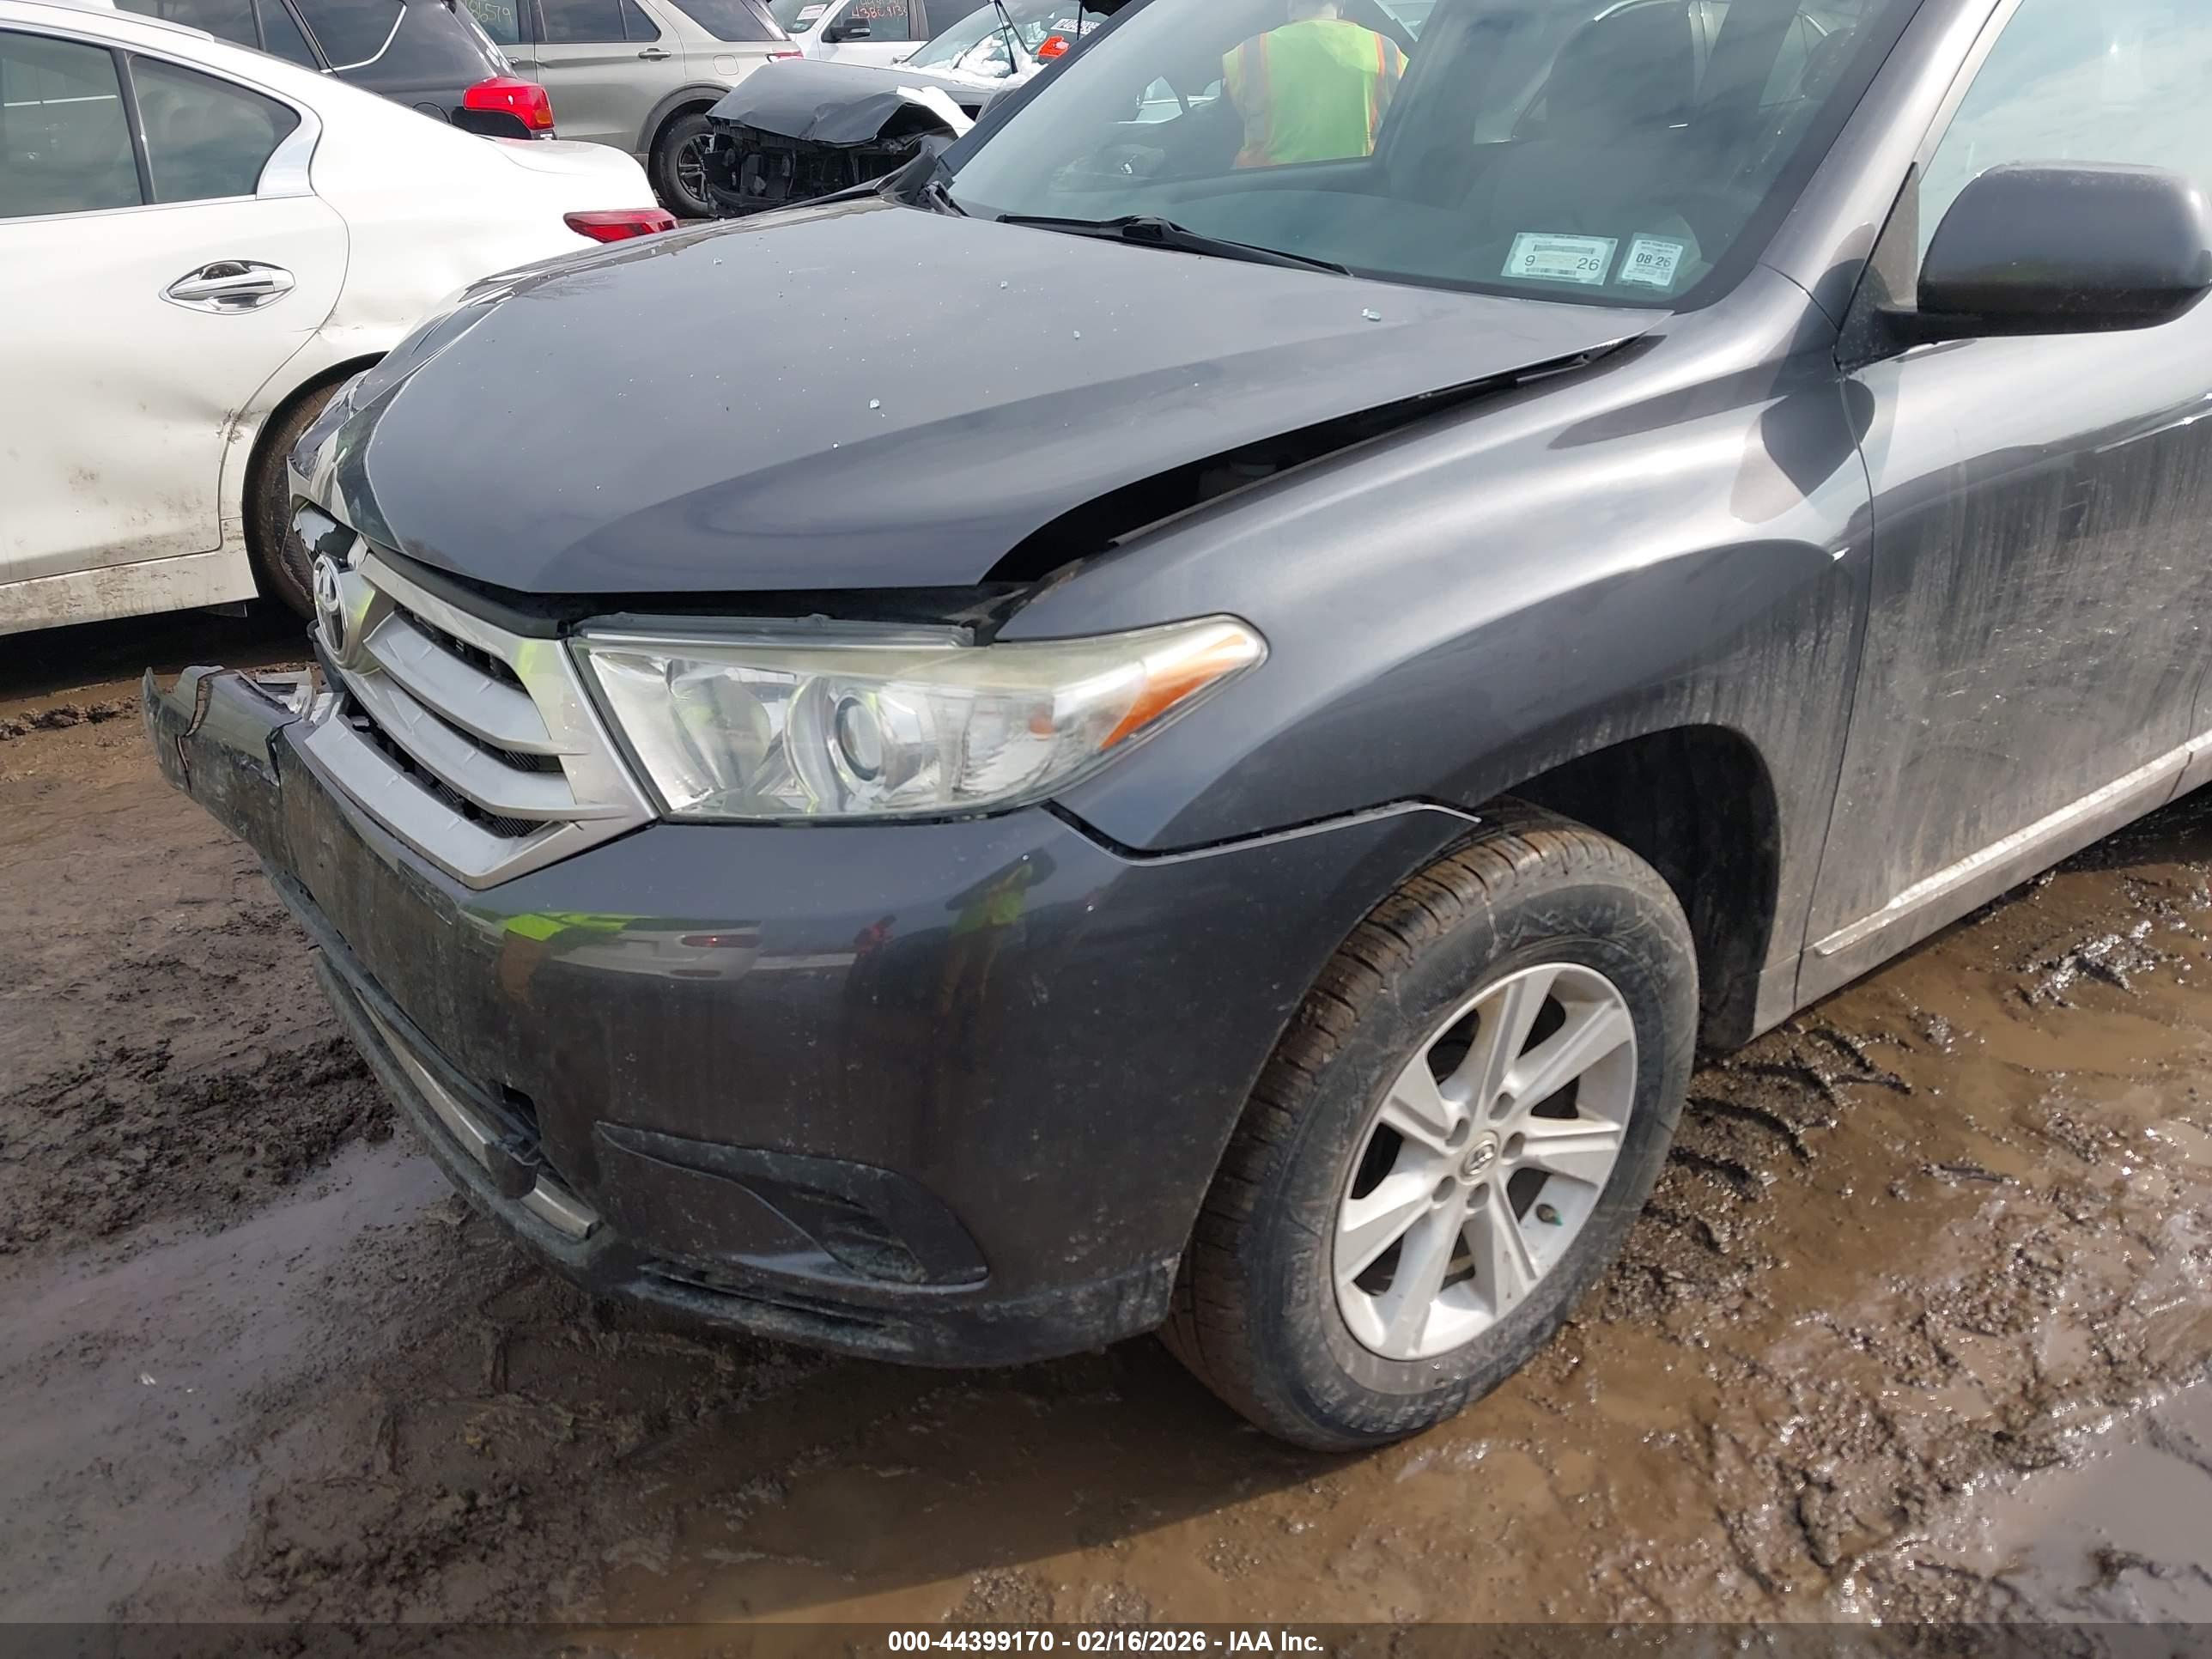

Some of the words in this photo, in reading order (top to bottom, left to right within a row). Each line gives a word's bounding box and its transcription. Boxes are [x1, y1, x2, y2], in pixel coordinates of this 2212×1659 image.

[1524, 254, 1535, 266] 9
[1577, 257, 1601, 270] 26
[1636, 252, 1653, 264] 08
[1655, 256, 1672, 267] 26
